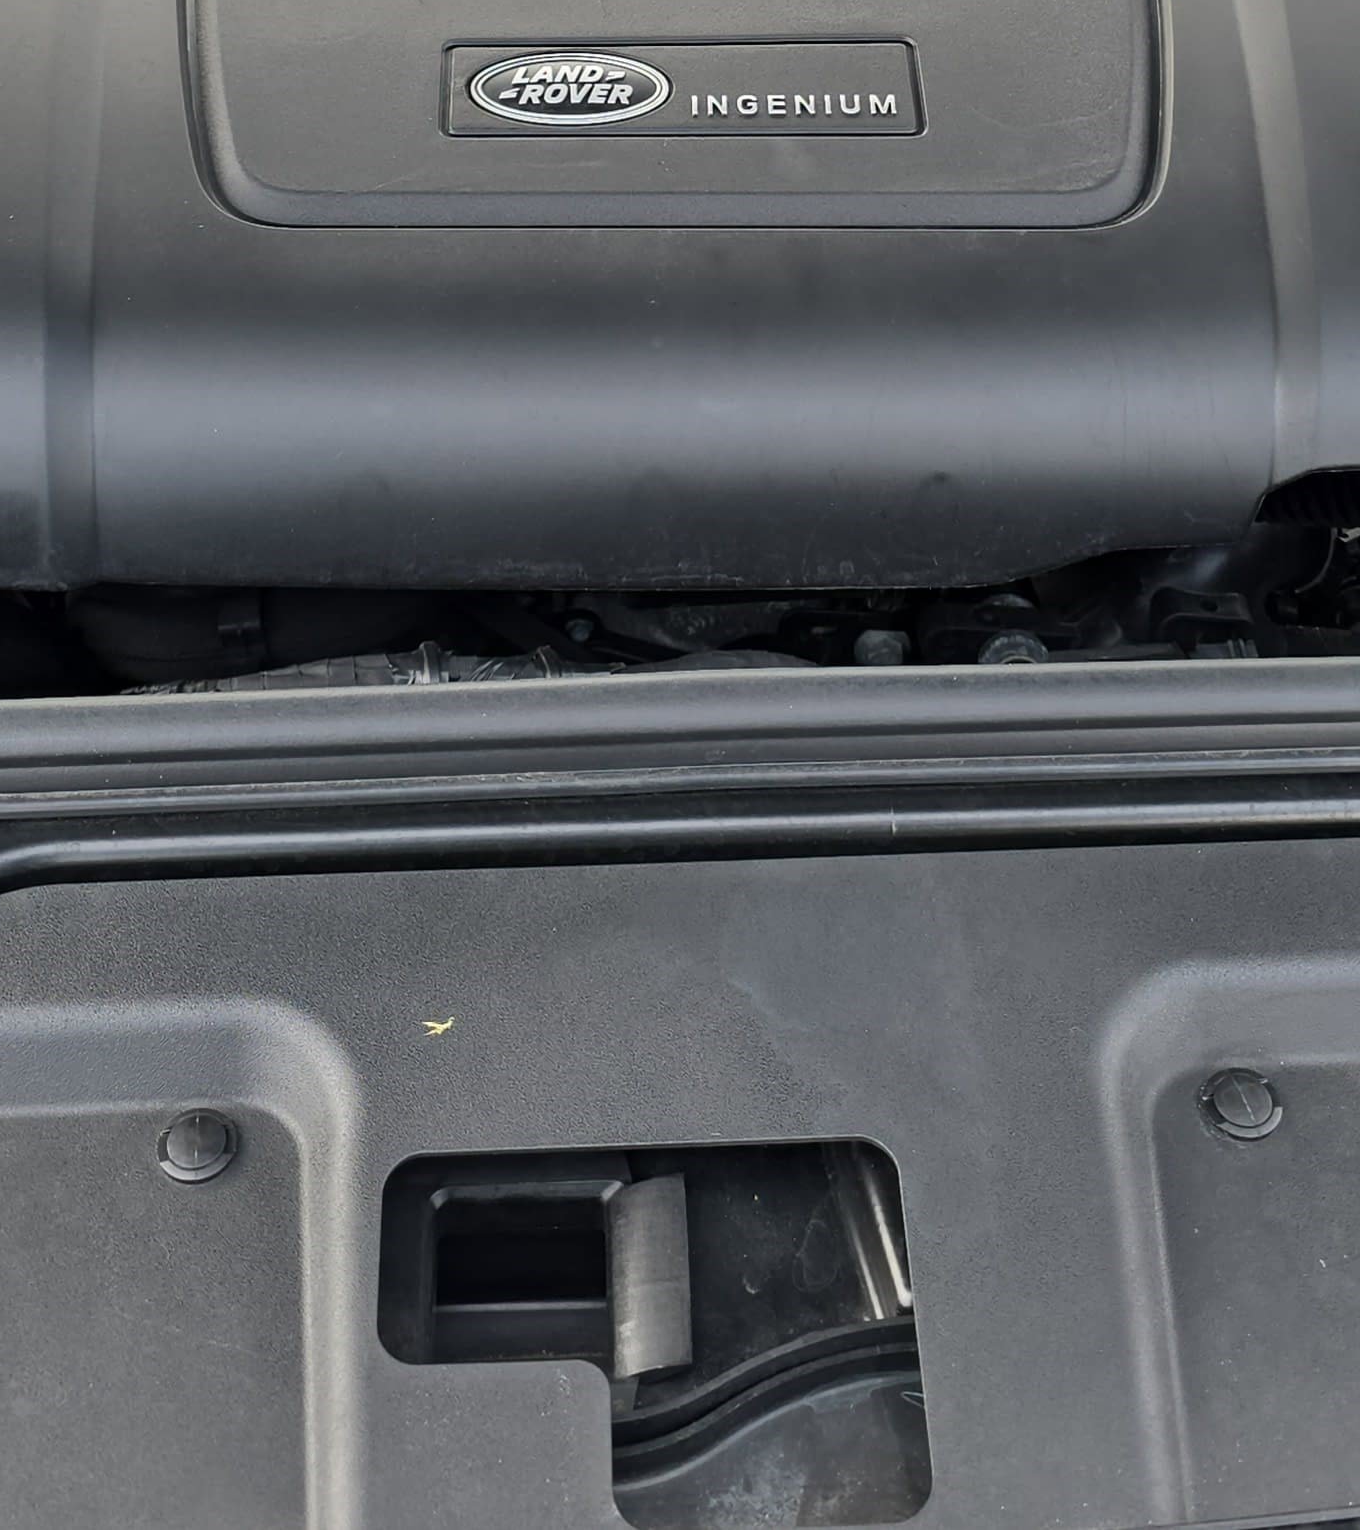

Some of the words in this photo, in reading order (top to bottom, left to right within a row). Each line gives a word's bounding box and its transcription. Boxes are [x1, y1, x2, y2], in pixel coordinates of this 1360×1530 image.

[511, 65, 607, 84] LAND
[518, 82, 633, 105] ROVER
[689, 93, 898, 118] INGENIUM
